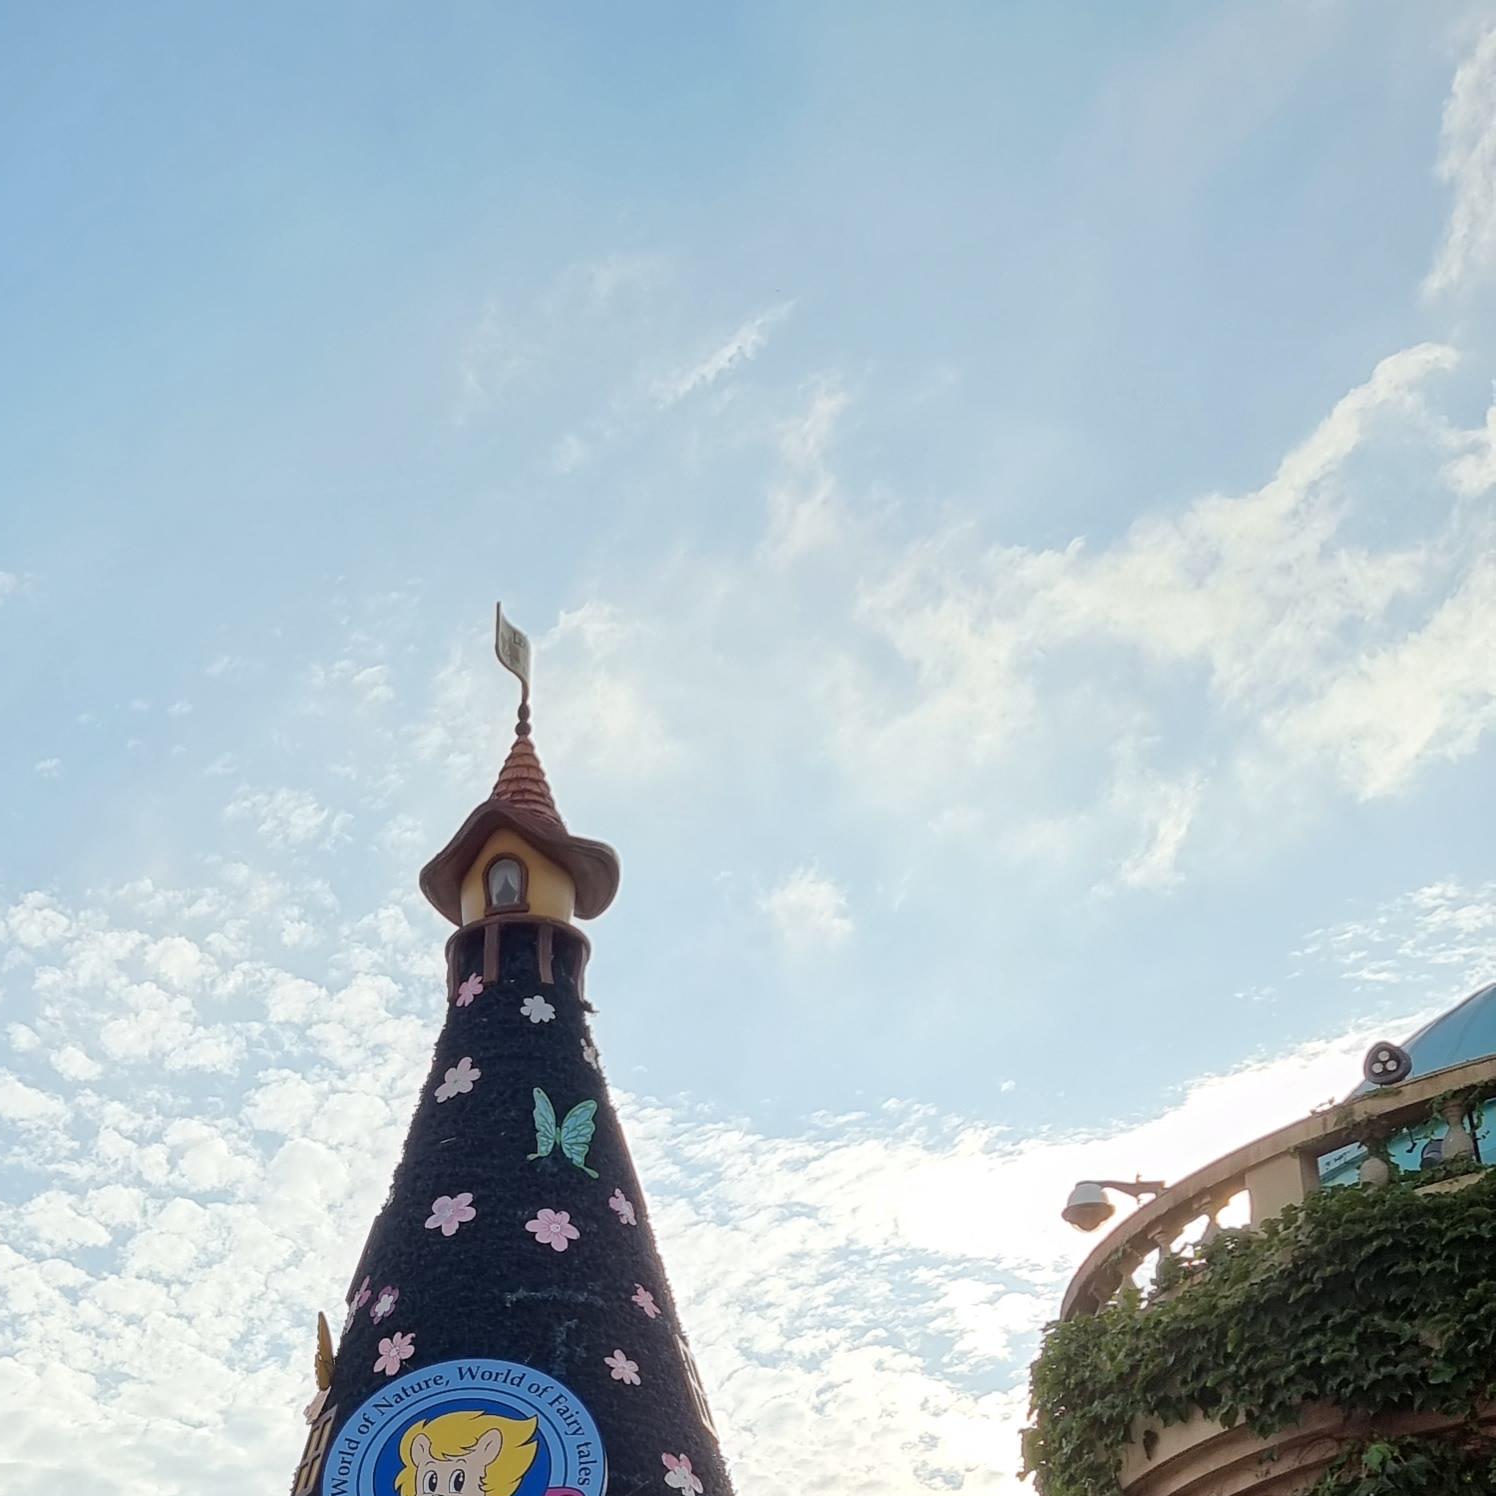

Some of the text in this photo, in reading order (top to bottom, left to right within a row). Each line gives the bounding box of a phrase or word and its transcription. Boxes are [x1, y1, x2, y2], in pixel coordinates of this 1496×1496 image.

[356, 1413, 376, 1434] of
[372, 1371, 450, 1416] Nature,
[456, 1364, 523, 1389] World
[530, 1380, 555, 1404] of
[547, 1391, 586, 1438] Fairy
[575, 1440, 599, 1487] tales
